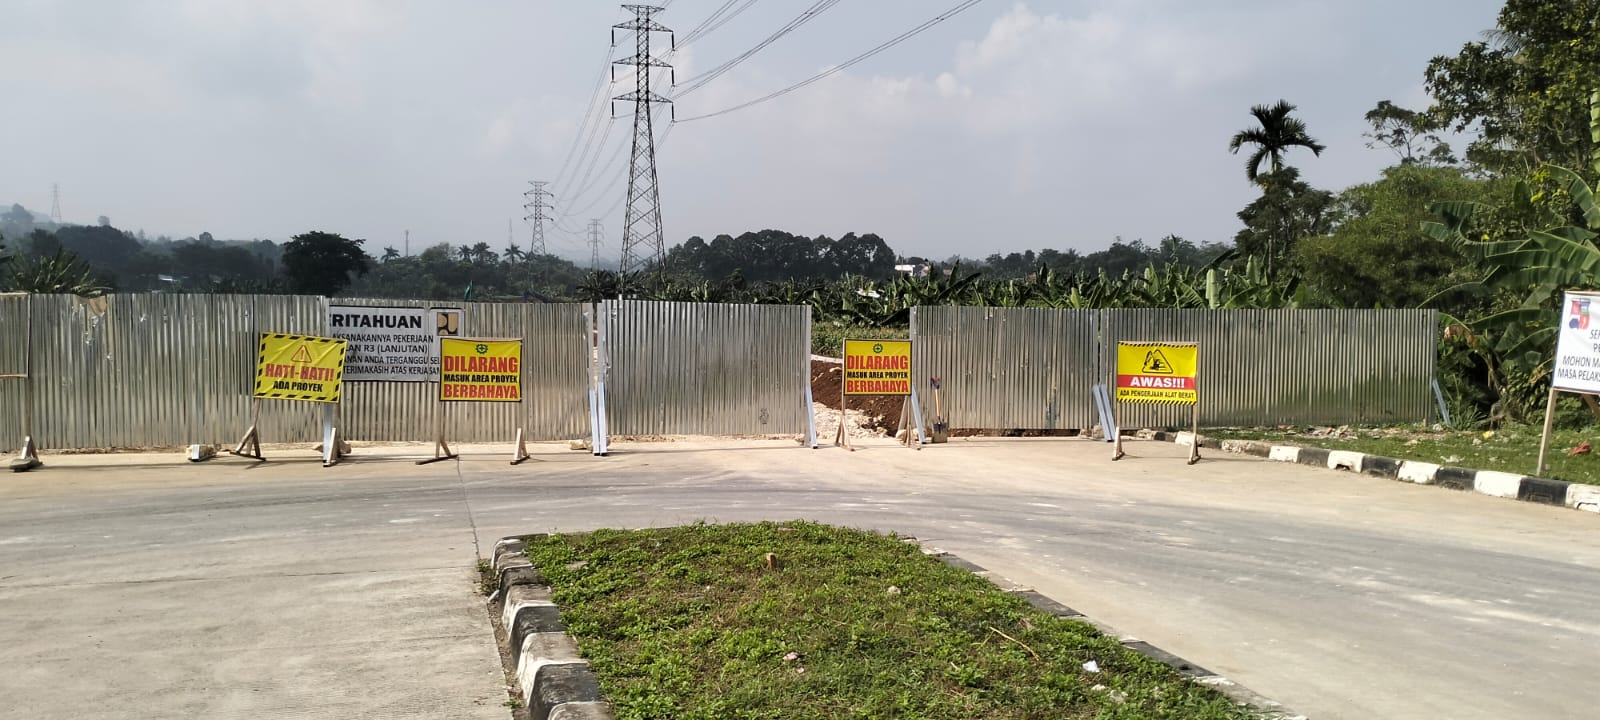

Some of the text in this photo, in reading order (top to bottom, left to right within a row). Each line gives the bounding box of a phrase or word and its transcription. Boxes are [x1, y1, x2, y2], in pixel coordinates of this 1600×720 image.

[329, 313, 422, 328] RITAHUAN
[393, 334, 433, 343] PEKERJAAN
[377, 344, 428, 354] (LANJUTAN)
[364, 355, 384, 364] ANDA
[386, 356, 428, 365] TERGANGGU
[444, 355, 518, 373] DILARANG
[847, 355, 909, 370] DILARANG
[1562, 355, 1591, 367] MOHON
[390, 366, 407, 374] ATAS
[885, 371, 908, 379] PROYEK
[1557, 367, 1577, 379] MASA
[444, 374, 518, 383] MASUK AREA PROYEK
[1129, 376, 1185, 388] AWAS!!!
[273, 380, 323, 392] ADA PROYEK
[443, 383, 518, 399] BERBAHAYA
[847, 380, 909, 392] BERBAHAYA
